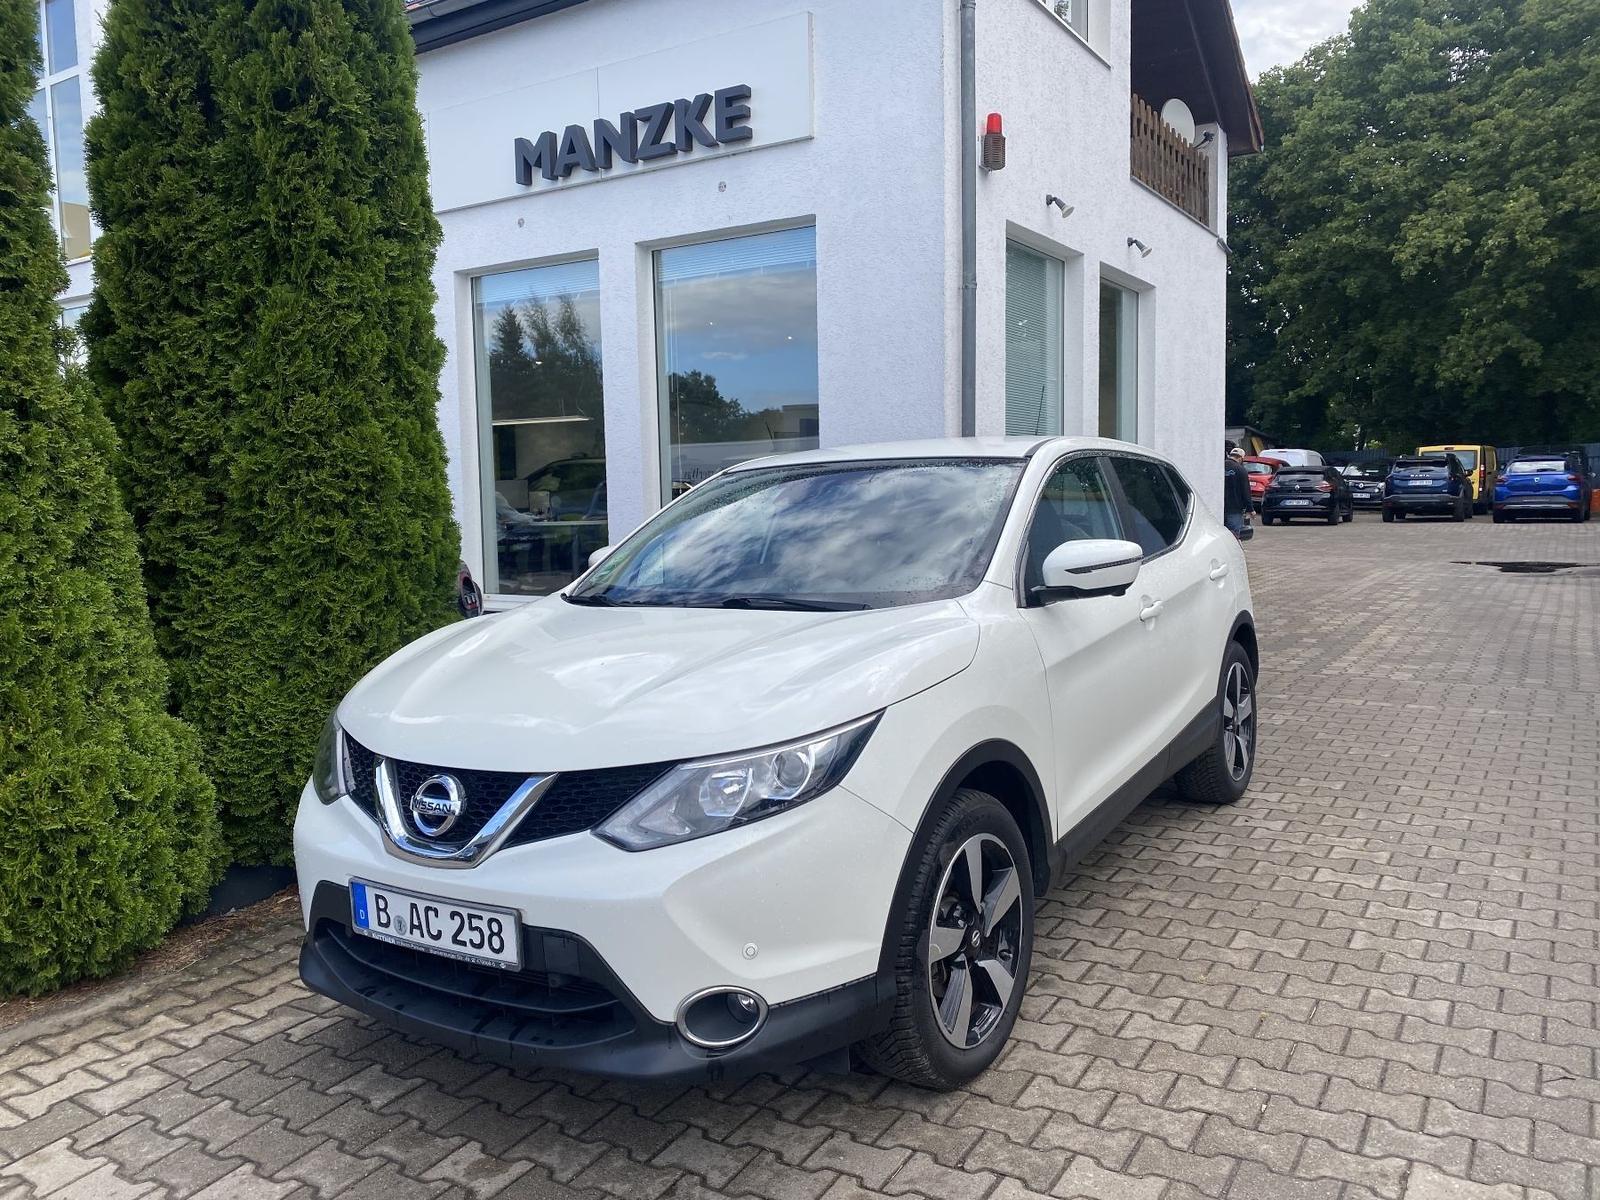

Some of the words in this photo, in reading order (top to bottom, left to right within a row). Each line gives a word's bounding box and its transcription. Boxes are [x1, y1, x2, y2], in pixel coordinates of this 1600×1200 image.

[514, 84, 753, 186] MANZKE
[412, 796, 452, 813] NISSAN
[359, 909, 366, 920] D
[374, 893, 391, 928] B
[409, 902, 442, 941] AC
[449, 910, 505, 954] 258
